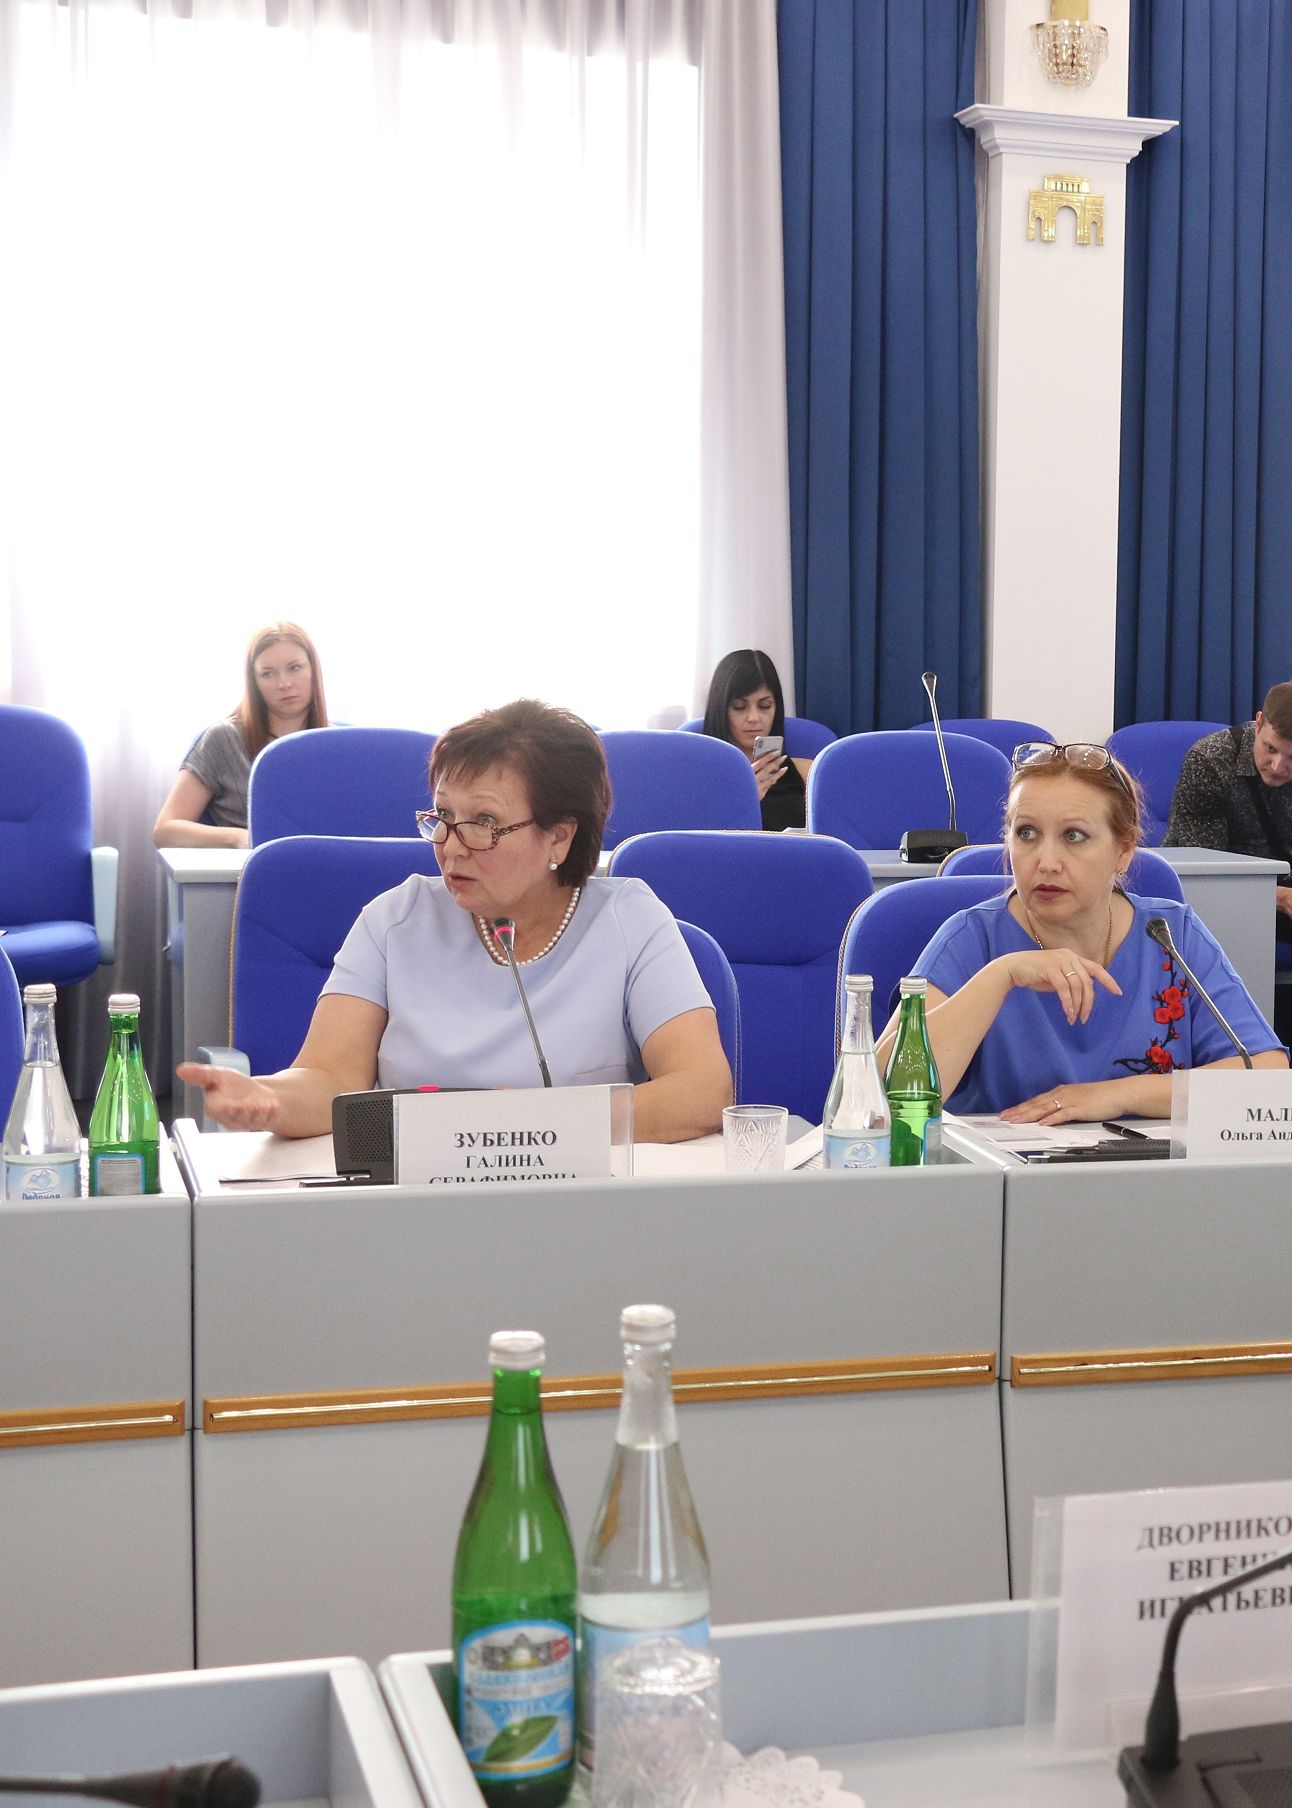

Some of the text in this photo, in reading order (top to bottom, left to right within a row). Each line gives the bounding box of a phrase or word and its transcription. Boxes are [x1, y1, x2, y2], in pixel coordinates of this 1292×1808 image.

[454, 1130, 557, 1148] ЗУБЕНКО
[1220, 1129, 1263, 1141] Ольга
[465, 1154, 545, 1169] ГАЛИНА
